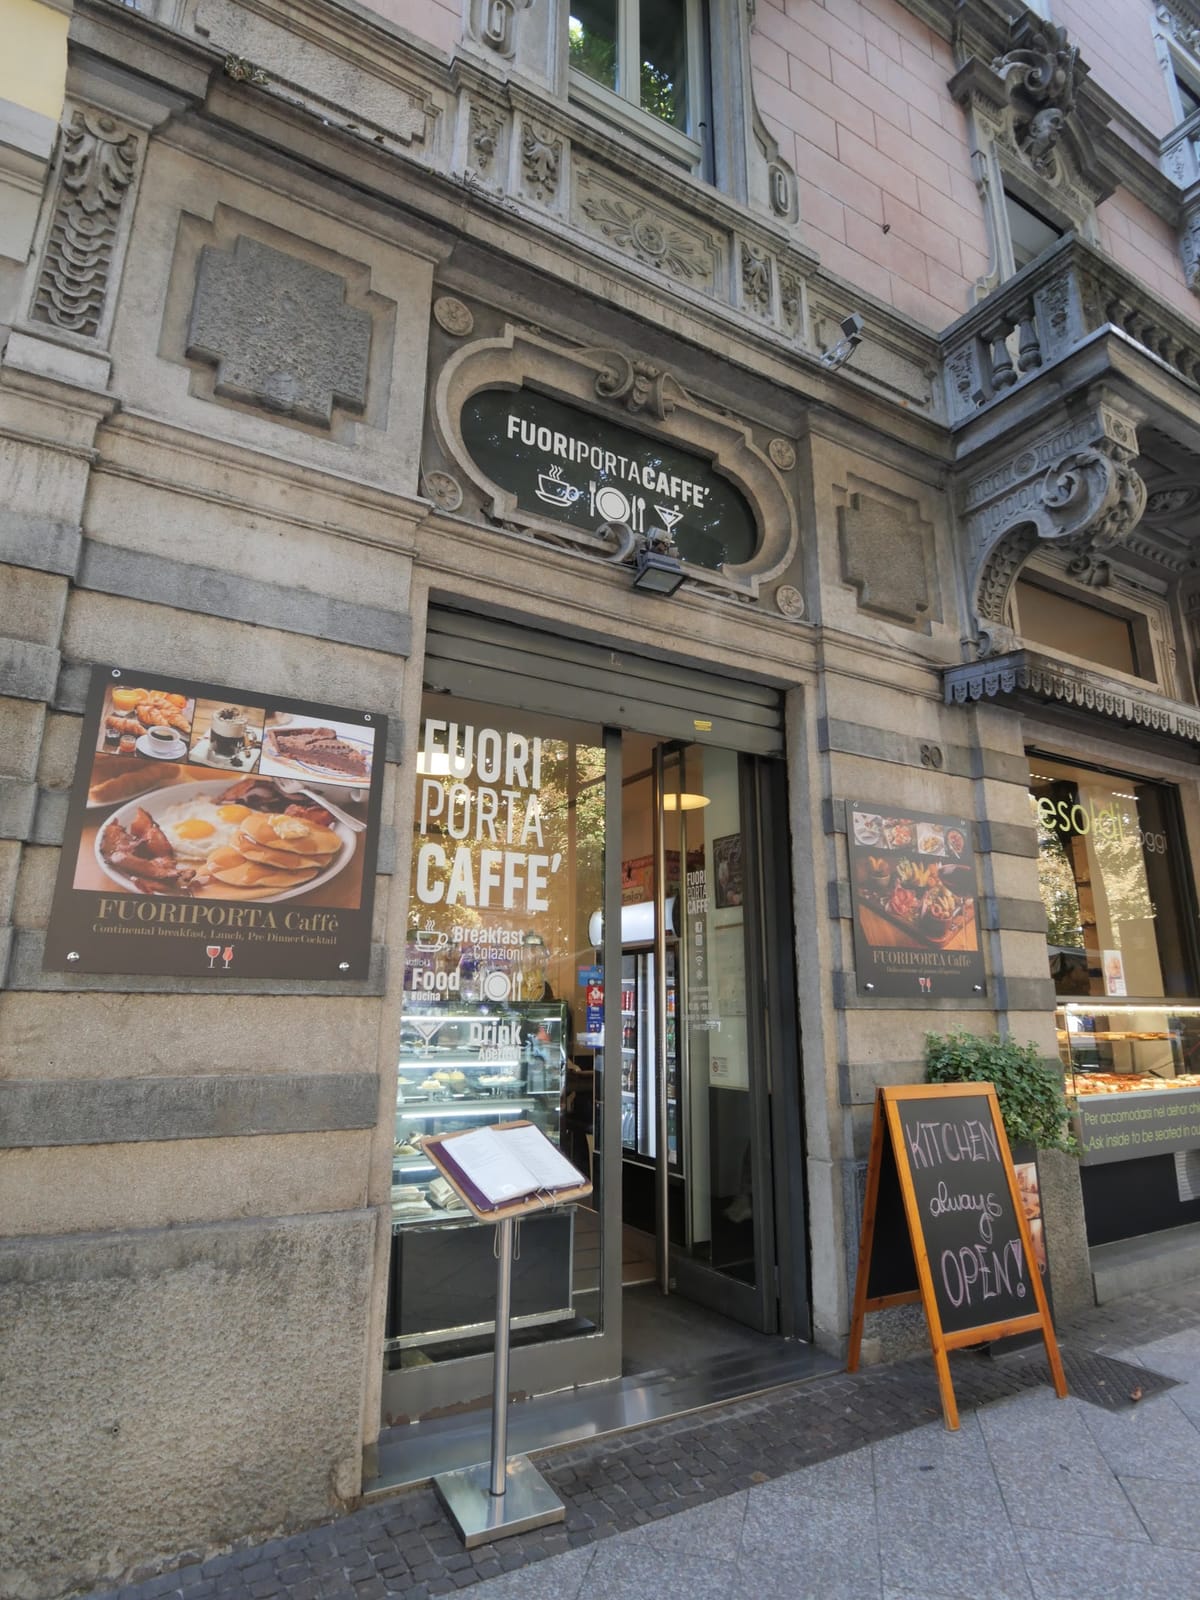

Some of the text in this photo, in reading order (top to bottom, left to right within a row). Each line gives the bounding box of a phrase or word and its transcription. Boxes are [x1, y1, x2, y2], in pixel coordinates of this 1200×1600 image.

[424, 718, 542, 789] FUORI
[420, 779, 544, 847] PORTA
[416, 843, 562, 911] CAFFE'
[97, 898, 339, 932] FUORIPORTA Caffè
[92, 922, 155, 936] Continental
[454, 926, 525, 945] Breakfast
[474, 945, 524, 961] Colazioni
[873, 950, 946, 966] FUORIPORTA
[411, 967, 461, 991] Food
[470, 1021, 522, 1046] Drink
[1084, 1112, 1098, 1126] Per
[1154, 1104, 1165, 1118] nel
[906, 1120, 1001, 1169] KITCHEN
[1089, 1134, 1104, 1151] Ask
[1105, 1131, 1130, 1148] inside
[1131, 1130, 1141, 1144] to
[1142, 1129, 1153, 1143] be
[1155, 1126, 1181, 1141] seated
[1182, 1125, 1190, 1137] in
[930, 1181, 1002, 1244] always
[941, 1239, 1026, 1308] OPEN!
